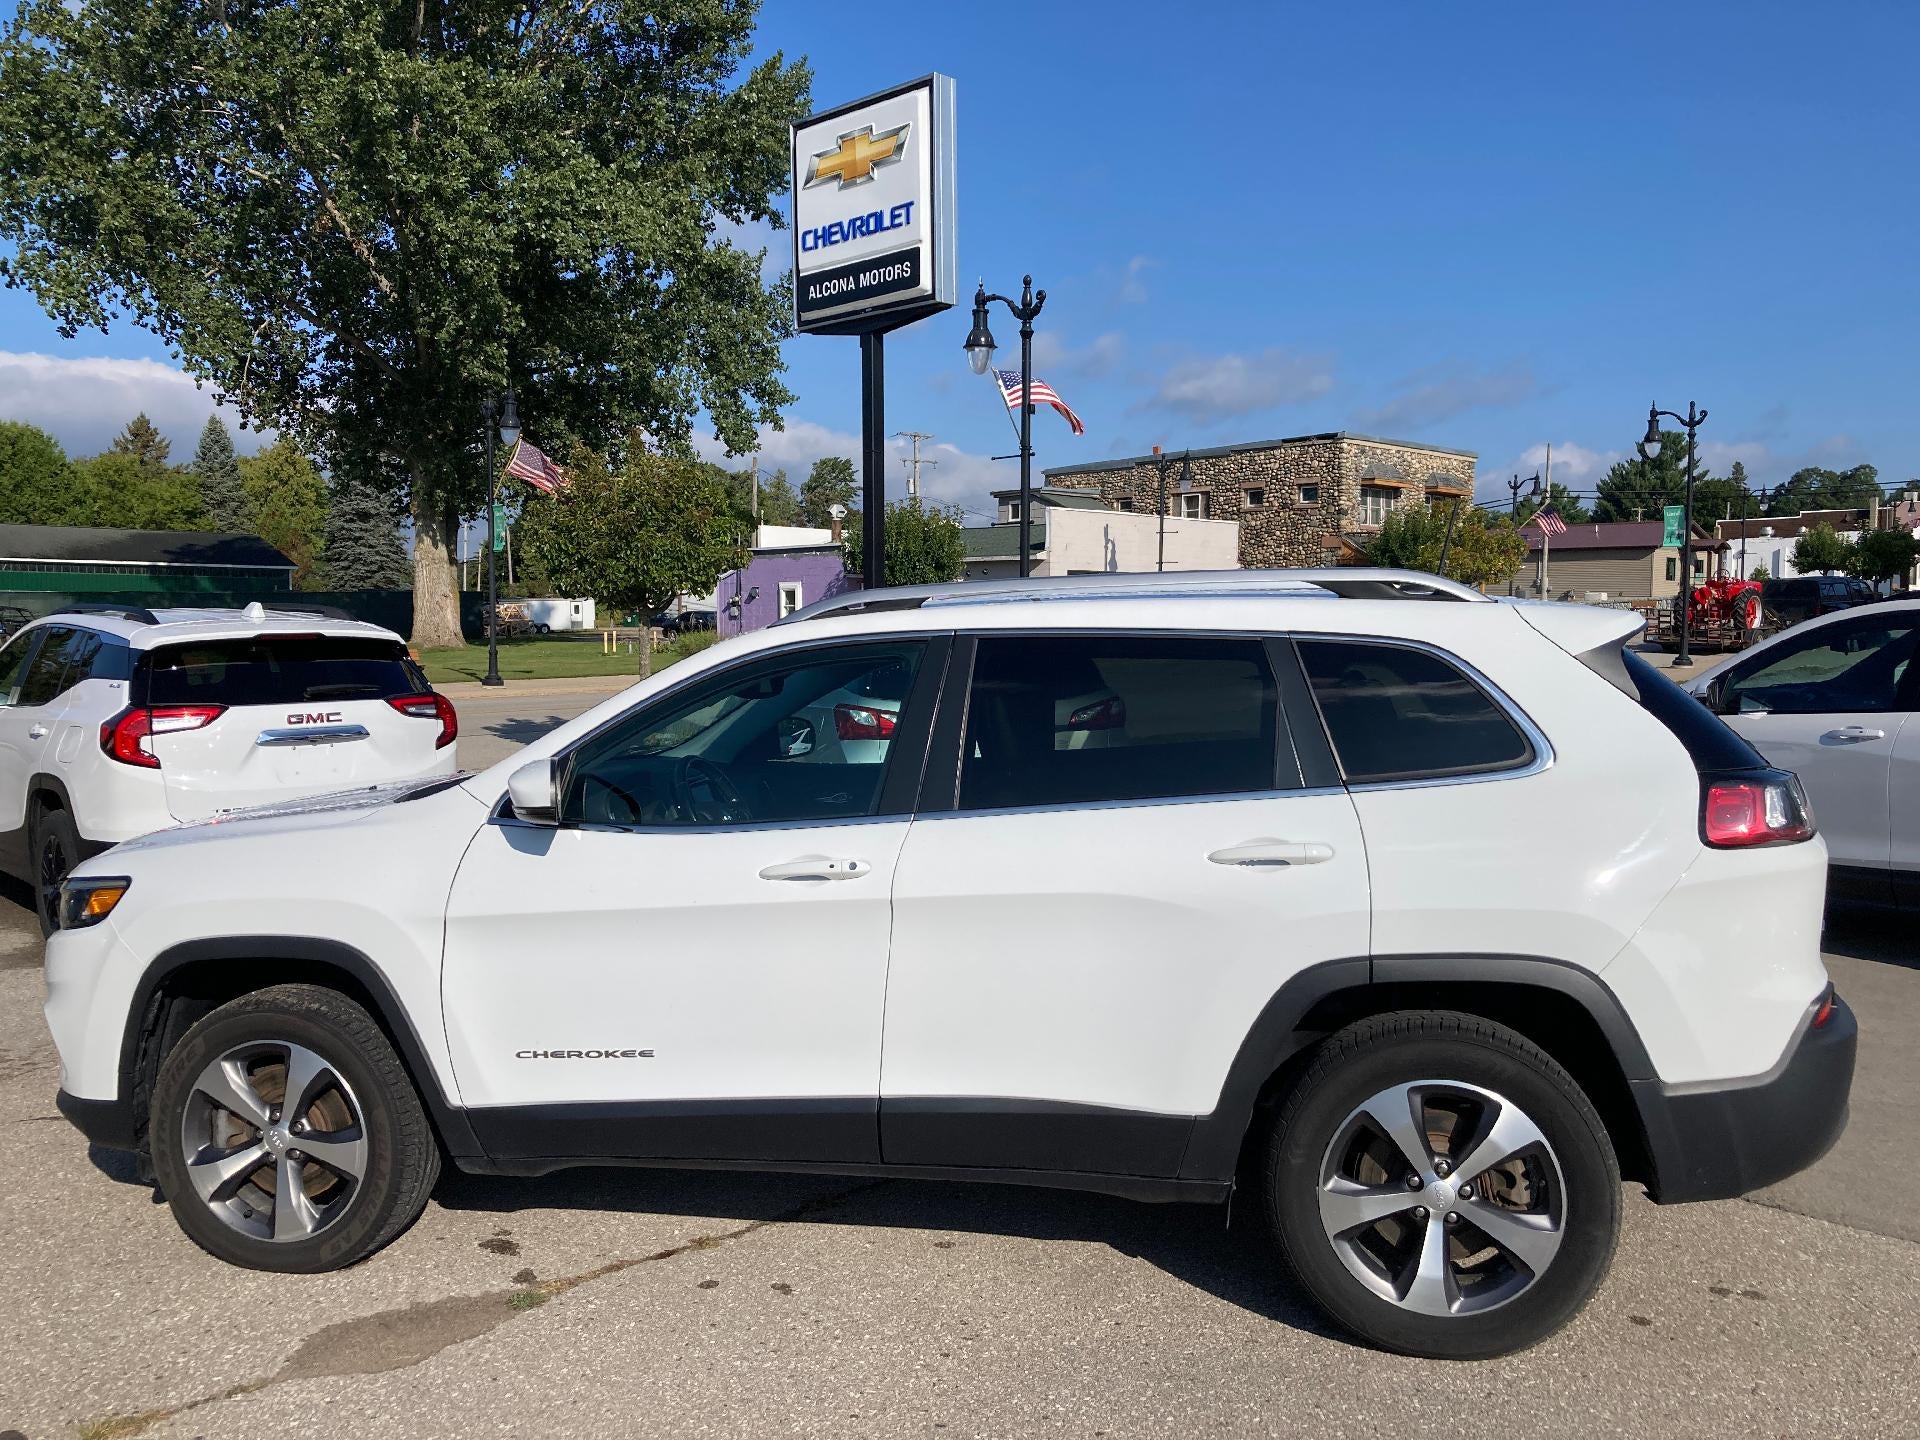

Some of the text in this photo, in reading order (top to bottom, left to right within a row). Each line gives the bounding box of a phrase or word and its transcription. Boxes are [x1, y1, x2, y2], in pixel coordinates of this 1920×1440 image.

[801, 201, 914, 252] CHEVROLET
[808, 262, 911, 300] ALCONA MOTORS
[287, 712, 343, 725] GMC
[515, 1049, 656, 1059] CHEROKEE
